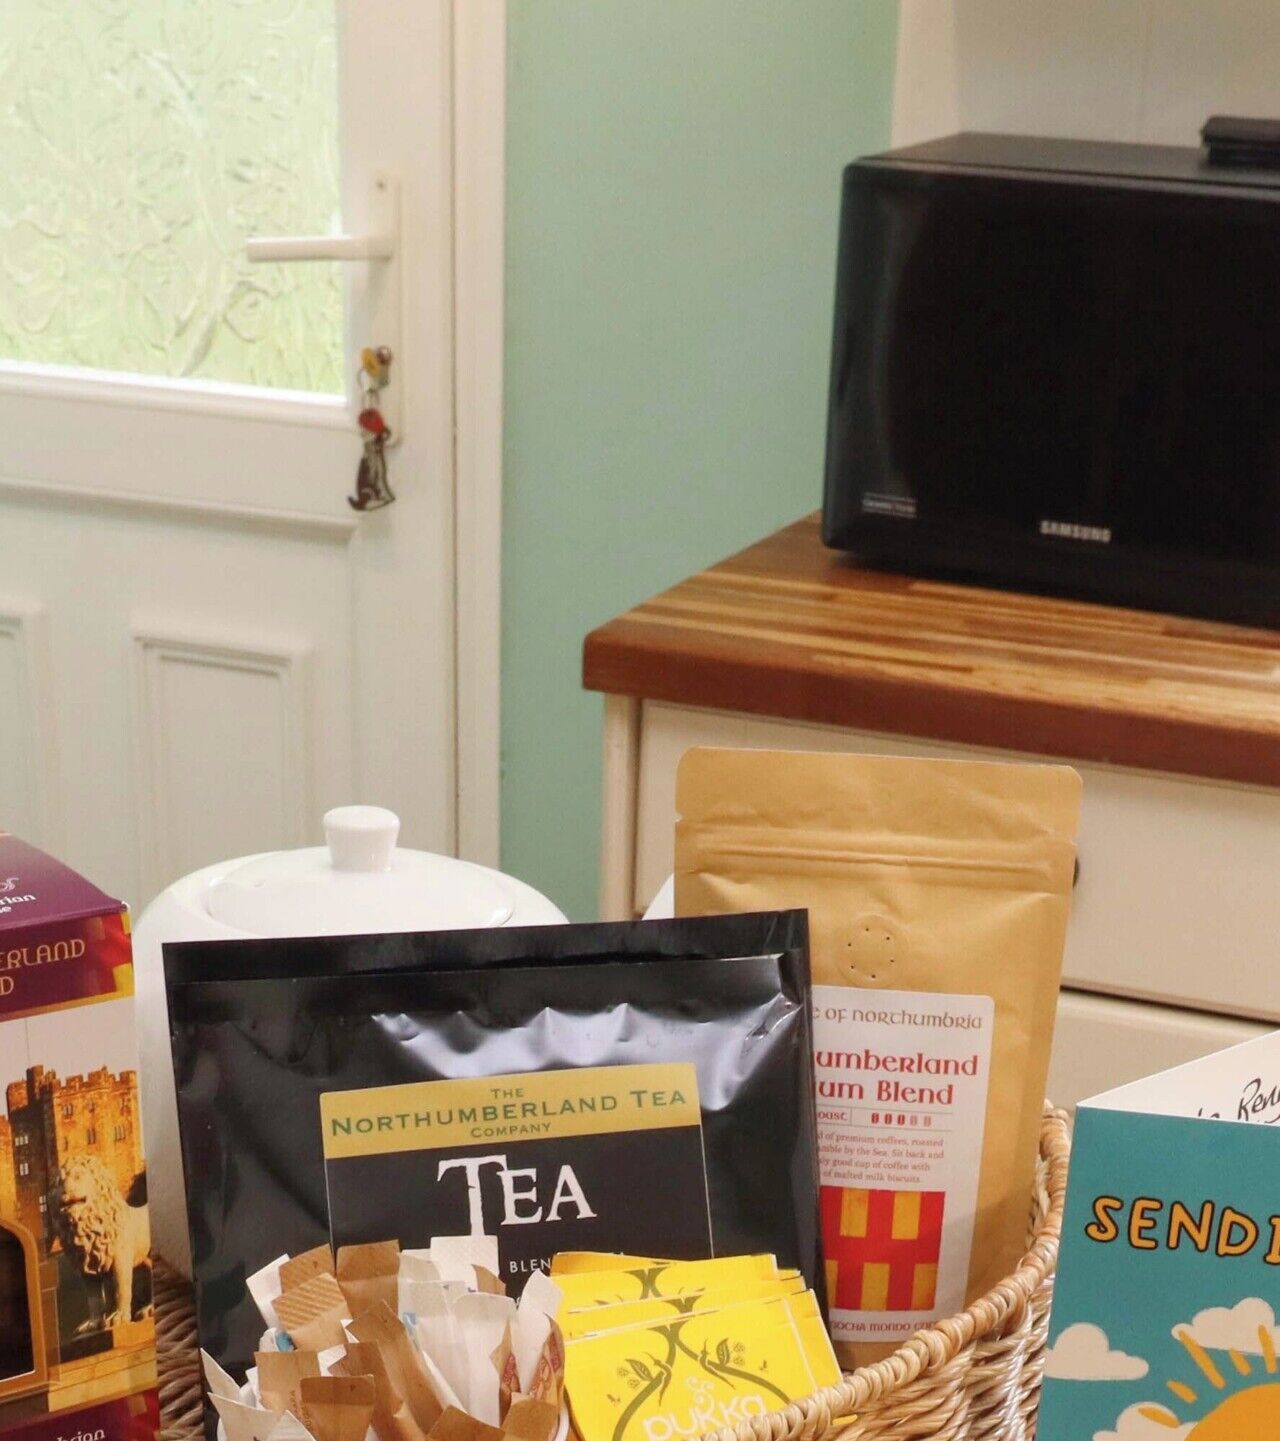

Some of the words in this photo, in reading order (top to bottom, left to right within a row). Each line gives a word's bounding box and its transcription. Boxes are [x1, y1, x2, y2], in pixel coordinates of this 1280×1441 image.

[1039, 519, 1111, 543] SAMSUNG
[490, 1087, 525, 1099] THE
[877, 1079, 954, 1105] Blend
[331, 1095, 618, 1137] NORTHUMBERLAND
[629, 1089, 686, 1109] TEA
[470, 1122, 552, 1139] COMPANY
[436, 1153, 598, 1238] TEA
